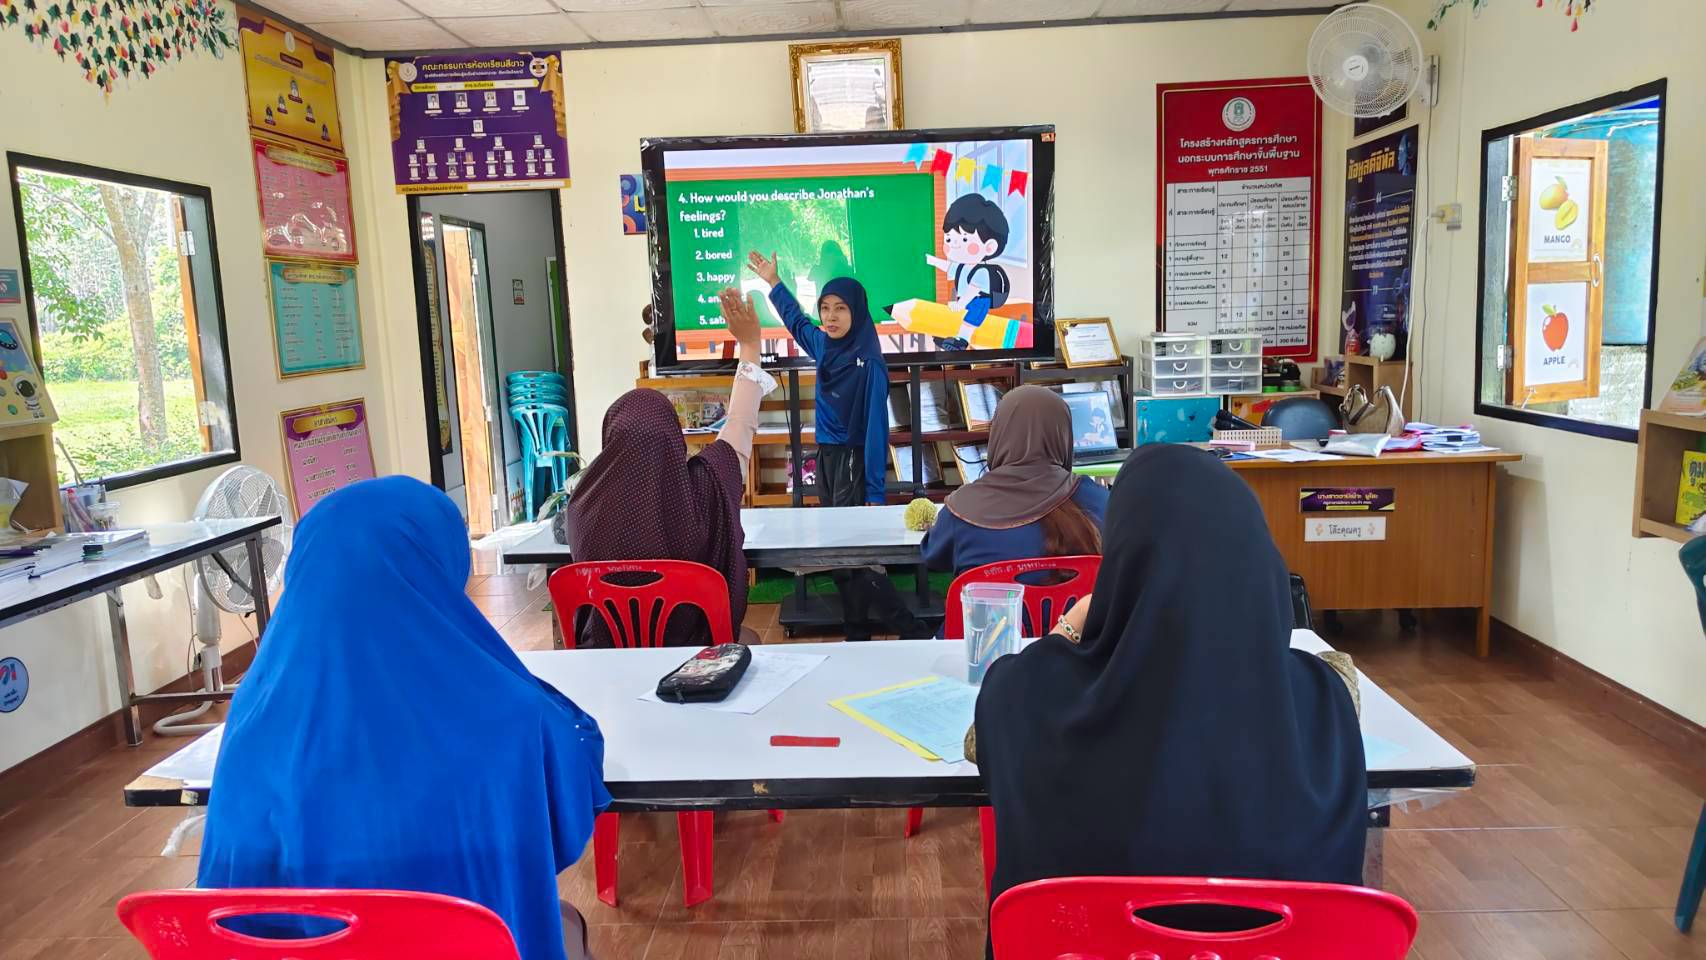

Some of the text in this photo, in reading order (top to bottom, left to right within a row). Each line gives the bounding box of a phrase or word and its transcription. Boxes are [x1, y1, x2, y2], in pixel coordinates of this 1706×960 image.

[422, 60, 524, 71] คณะกรรมการห้องเรียนสีขาว
[1180, 134, 1297, 149] โครงสร้างหลักสูตรการศึกษา
[1178, 147, 1300, 164] นอกระบบการศึกษาขั้นพื้นฐาน
[1208, 164, 1268, 177] พุทธศักราช 2551
[678, 187, 875, 205] 4. How would you describe Jonathan's
[679, 210, 726, 224] feelings?
[701, 228, 724, 239] tired
[1543, 234, 1572, 244] MANGO
[695, 249, 732, 261] 2. bored
[696, 271, 736, 285] 3. happy
[698, 294, 707, 305] 4.
[699, 315, 708, 326] 5.
[1543, 356, 1566, 366] APPLE
[1328, 524, 1362, 538] โต๊ะคุณครู
